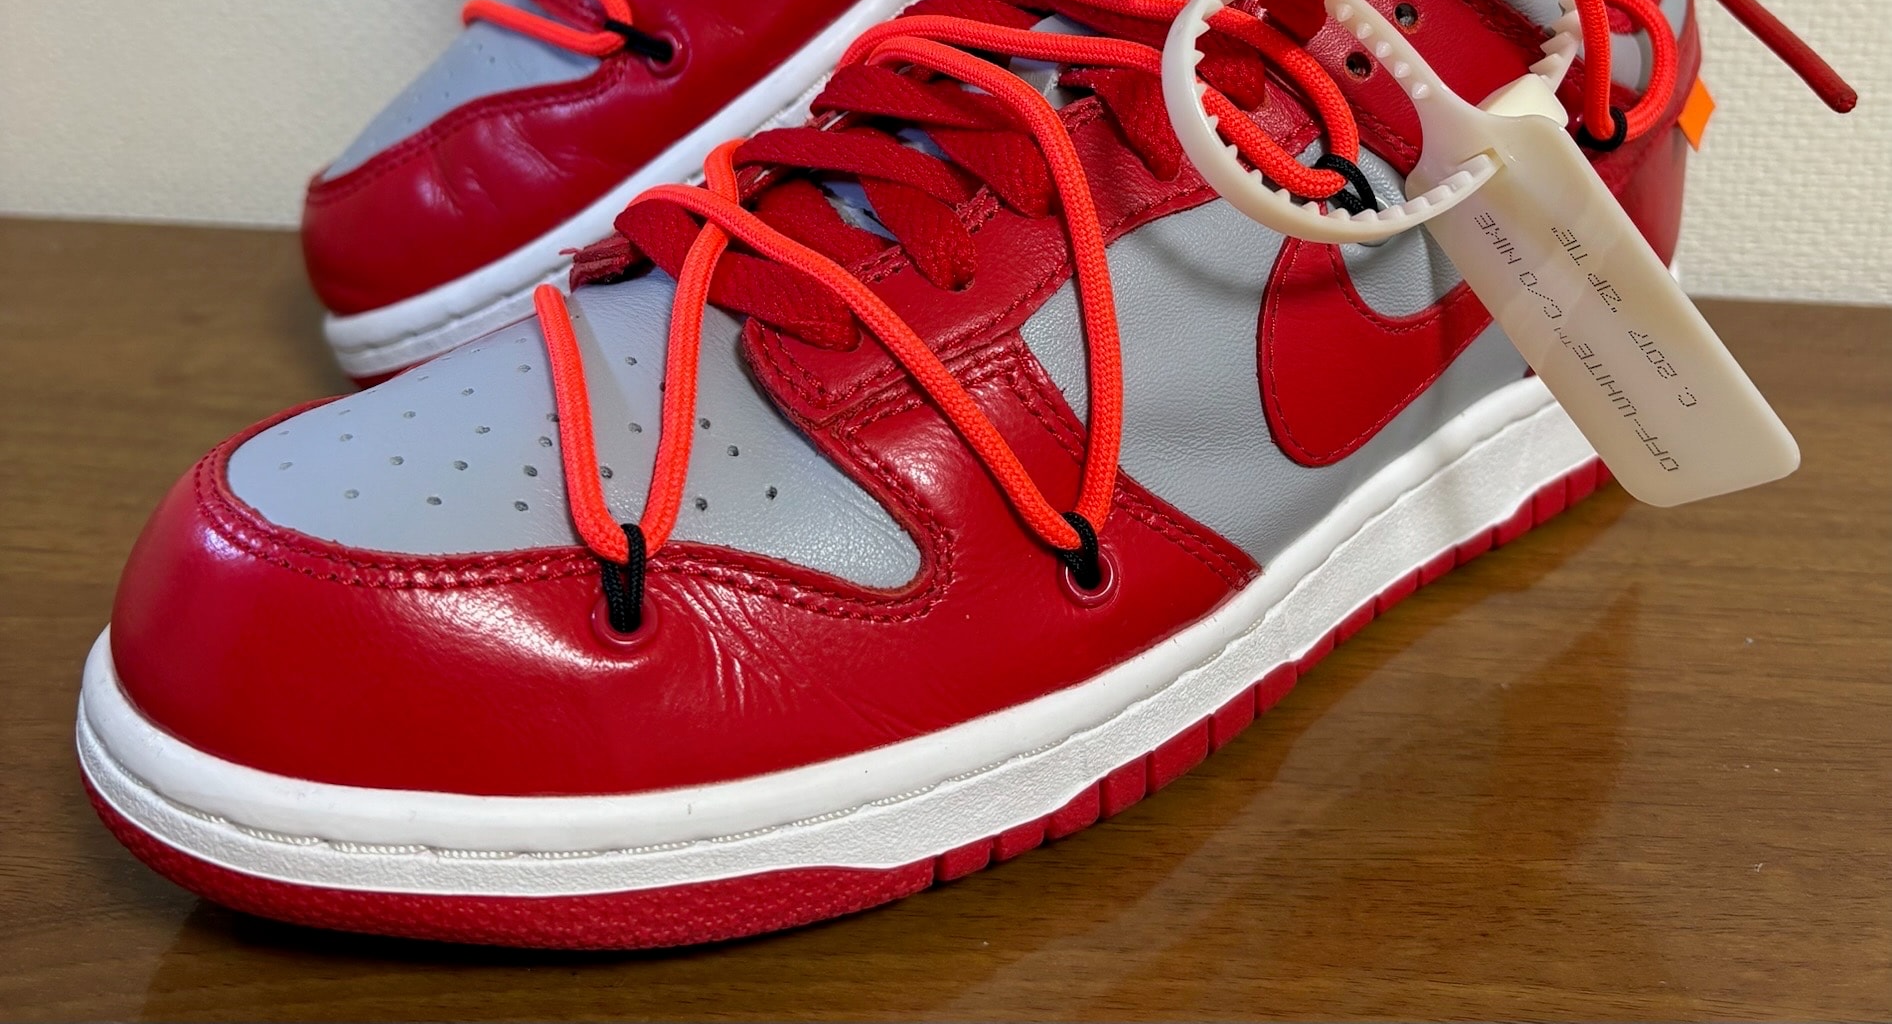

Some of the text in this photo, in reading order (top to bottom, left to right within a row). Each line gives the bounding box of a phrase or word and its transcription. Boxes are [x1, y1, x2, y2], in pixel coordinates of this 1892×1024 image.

[1474, 212, 1522, 265] NIKE
[1551, 226, 1589, 267] TIE"
[1519, 271, 1563, 320] C/O
[1587, 273, 1623, 314] "ZIP
[1627, 330, 1679, 380] 2017
